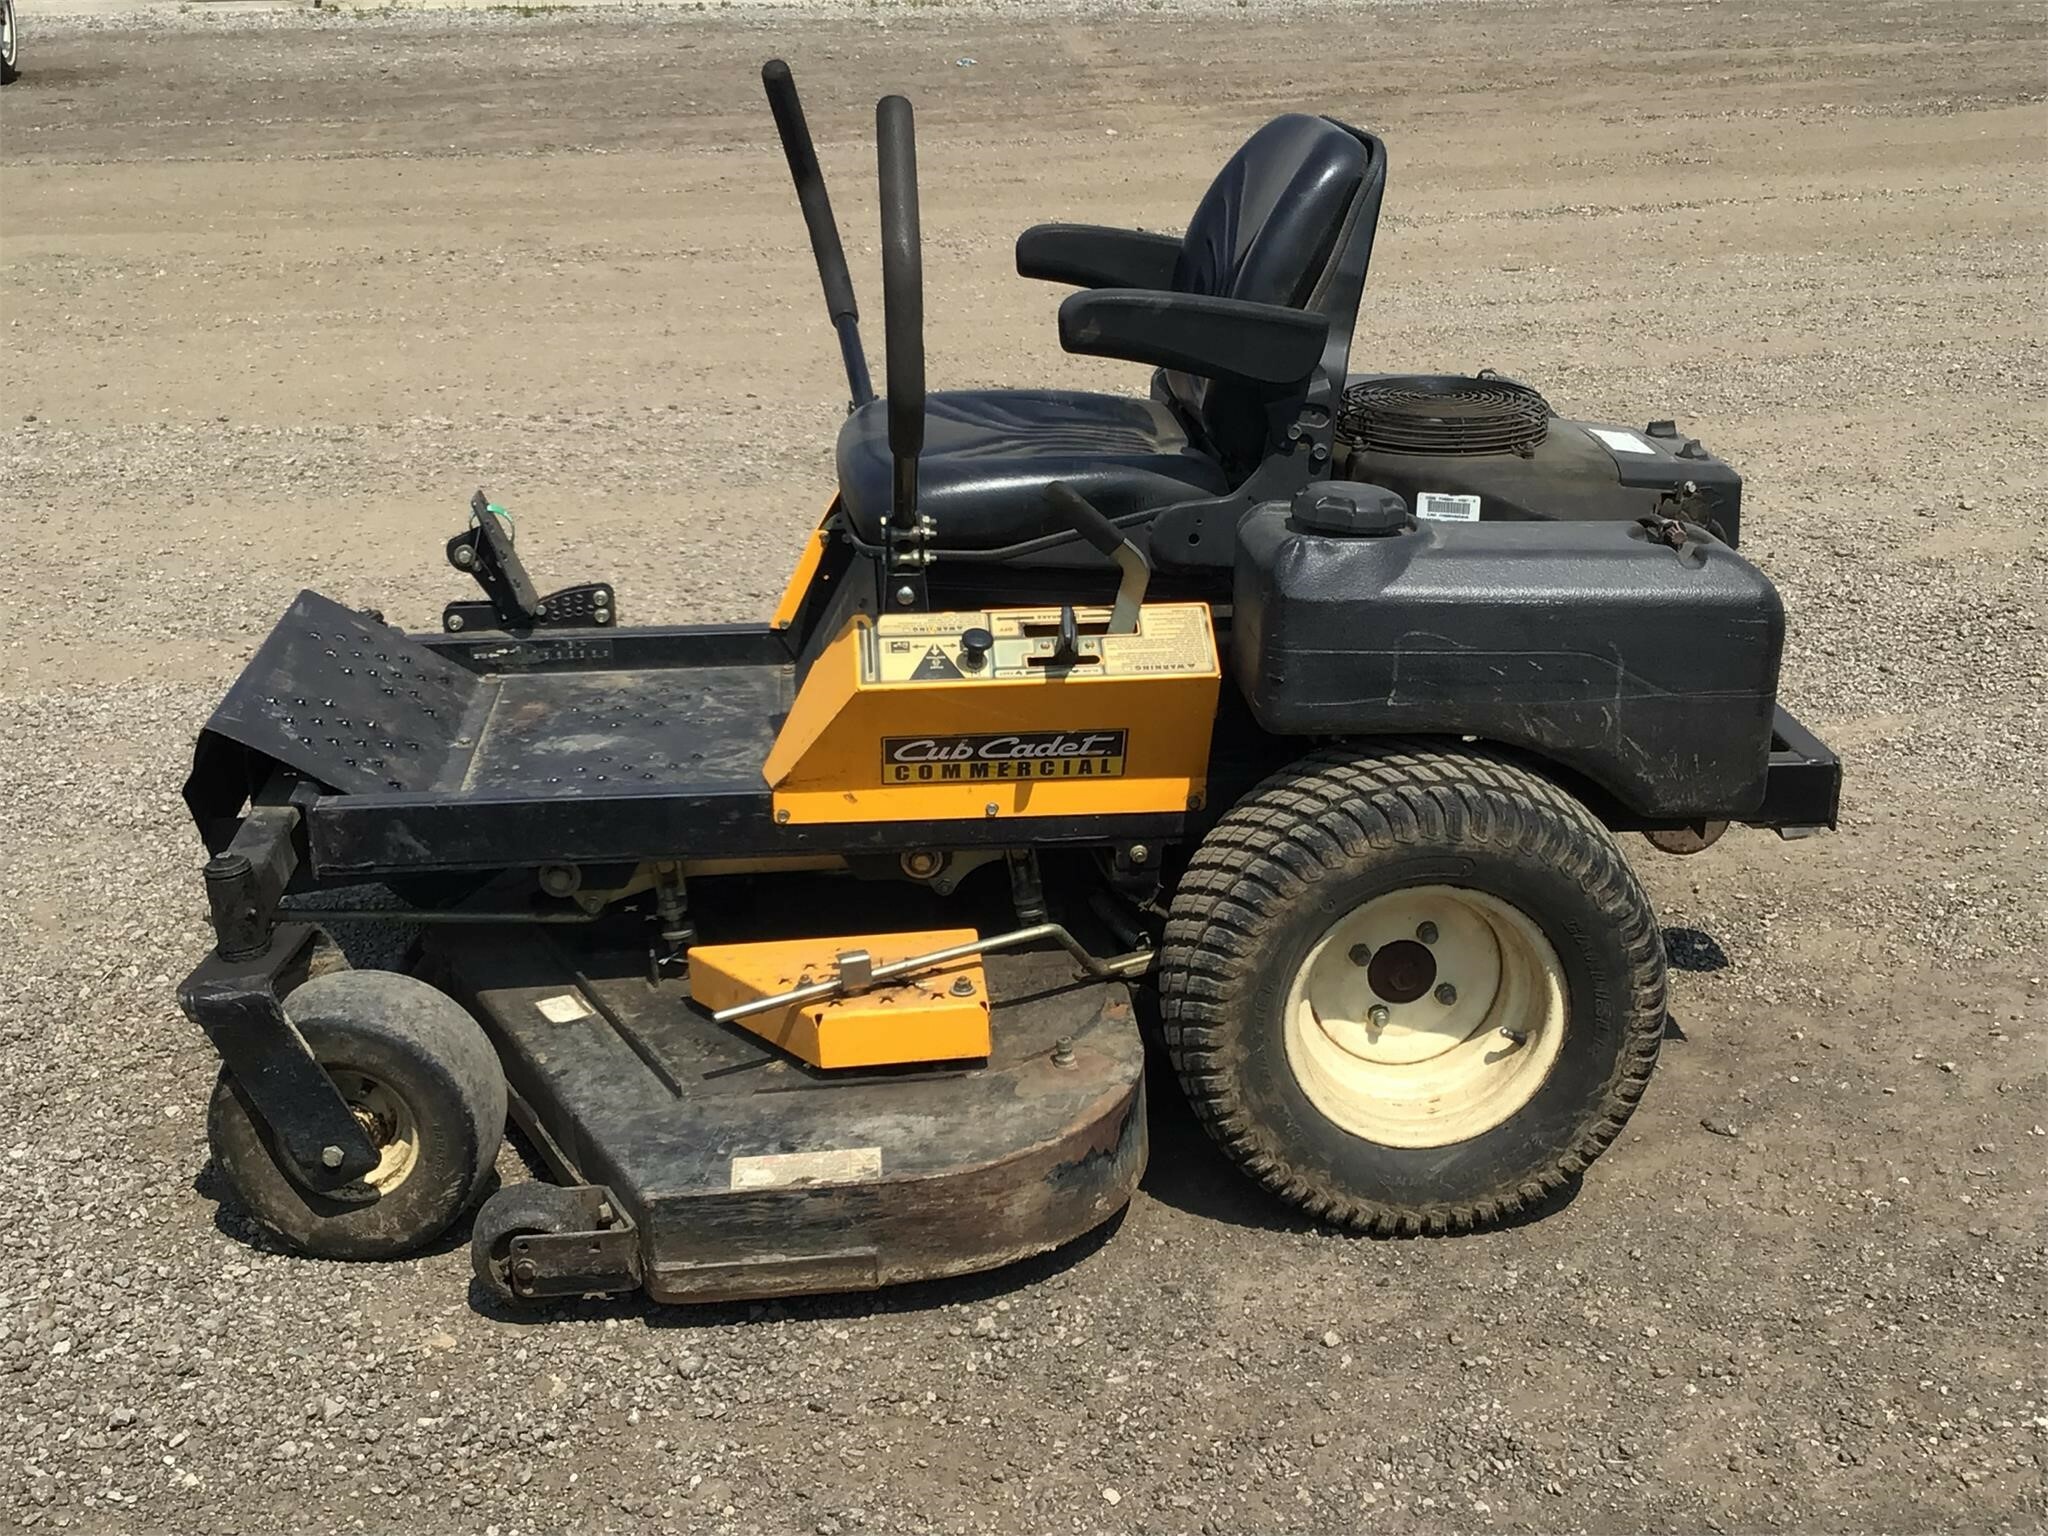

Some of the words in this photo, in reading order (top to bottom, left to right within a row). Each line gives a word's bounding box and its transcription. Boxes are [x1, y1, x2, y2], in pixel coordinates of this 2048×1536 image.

[1135, 663, 1186, 671] WARNING
[893, 738, 974, 762] Cub
[894, 757, 1112, 781] COMMERCIAL
